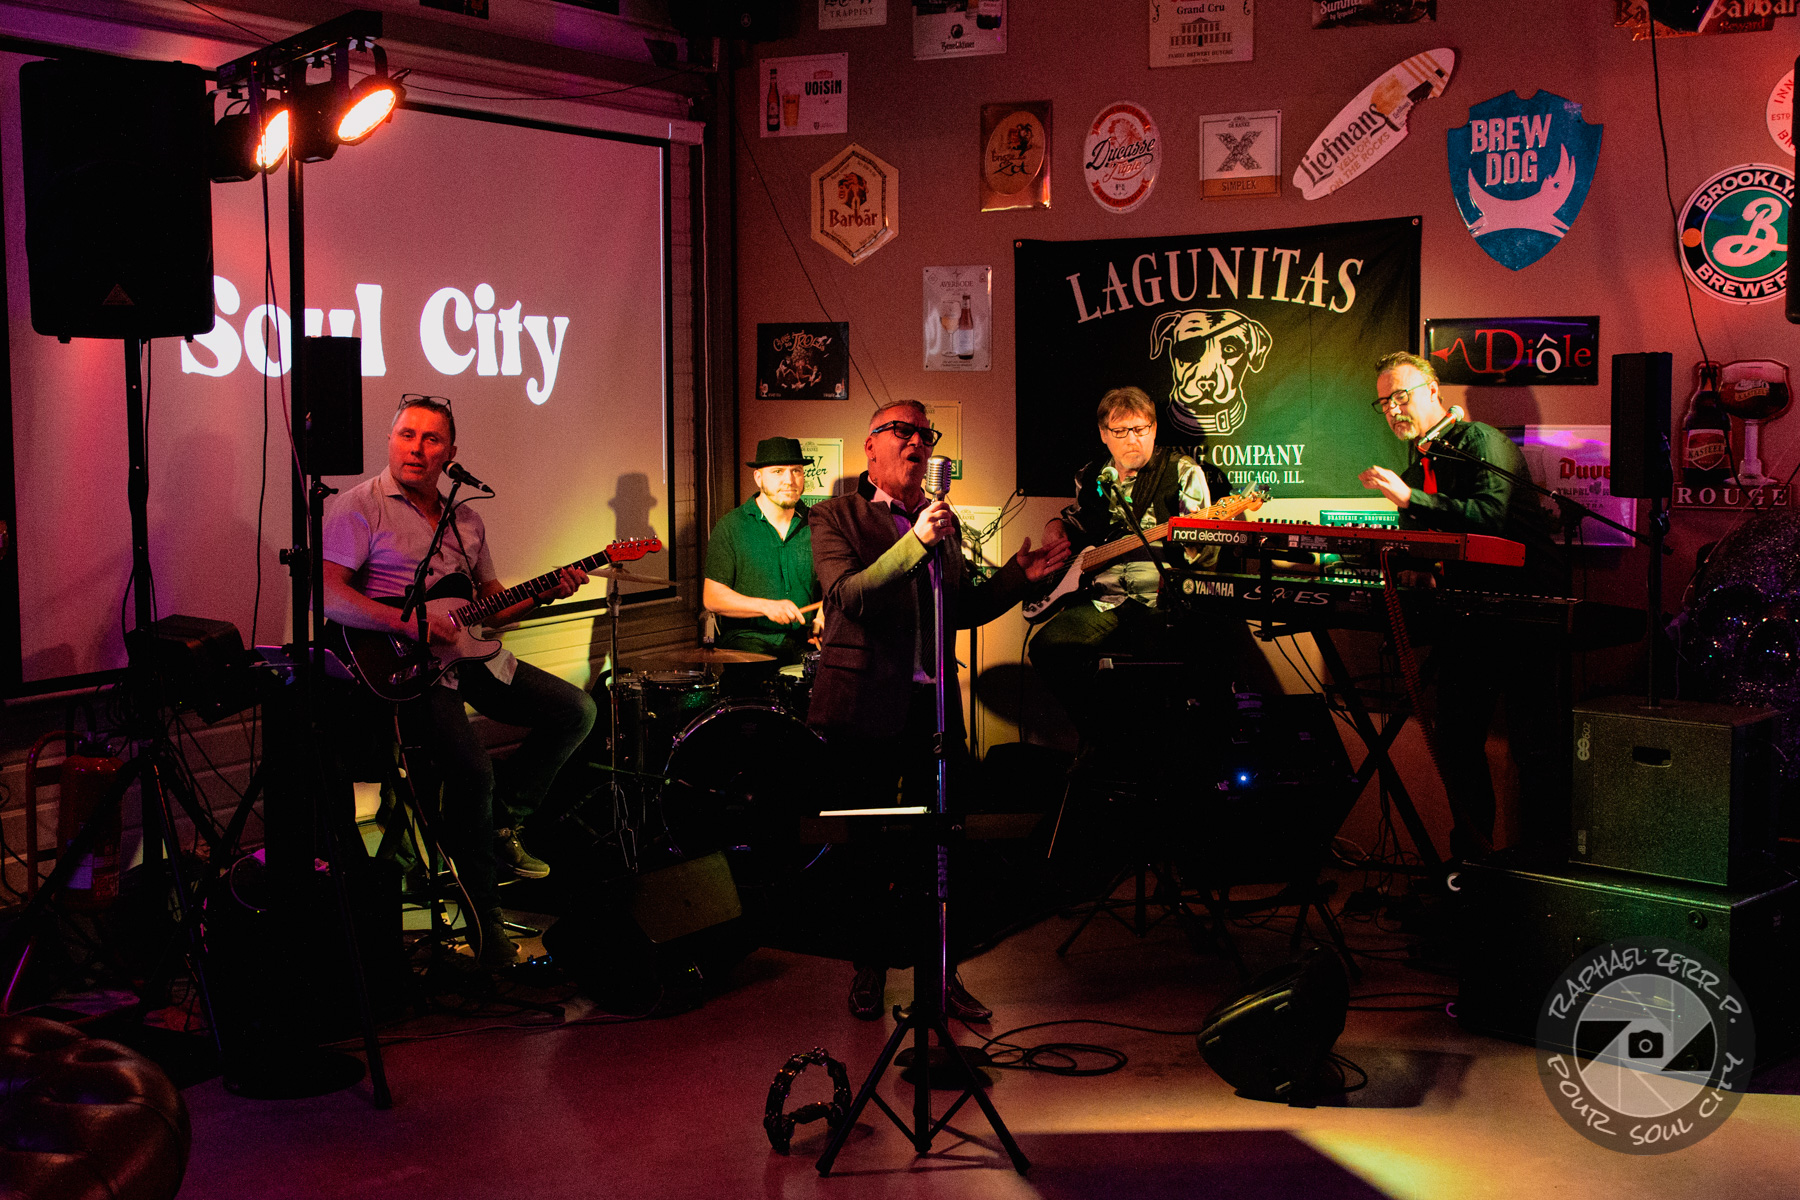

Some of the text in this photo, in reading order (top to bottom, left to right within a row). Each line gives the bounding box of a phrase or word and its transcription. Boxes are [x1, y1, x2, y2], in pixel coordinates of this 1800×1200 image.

[830, 7, 873, 18] TRAPPIST
[1177, 3, 1225, 15] Grand Cru
[1300, 103, 1400, 188] Liefmans
[1470, 113, 1553, 155] BREW
[1086, 137, 1156, 170] Ducasse
[1216, 130, 1262, 172] X
[1343, 162, 1361, 179] THE
[1360, 131, 1391, 162] ROCKS
[1484, 150, 1538, 187] DOG
[1221, 180, 1257, 191] SIMPLEX
[1695, 170, 1796, 213] BROOKLY
[1066, 246, 1364, 325] LAGUNITAS
[1695, 262, 1788, 298] BREWER
[419, 282, 570, 405] City
[1462, 328, 1592, 374] Diôle
[1211, 443, 1305, 467] COMPANY
[1559, 457, 1611, 480] Duve
[804, 468, 828, 478] itter
[1227, 470, 1280, 485] CHICAGO,
[1283, 471, 1305, 484] ILL.
[1676, 487, 1788, 507] ROUGE
[1173, 529, 1197, 541] nord
[1199, 530, 1232, 543] electro
[1195, 580, 1235, 598] YAMAHA
[1293, 590, 1331, 606] ES
